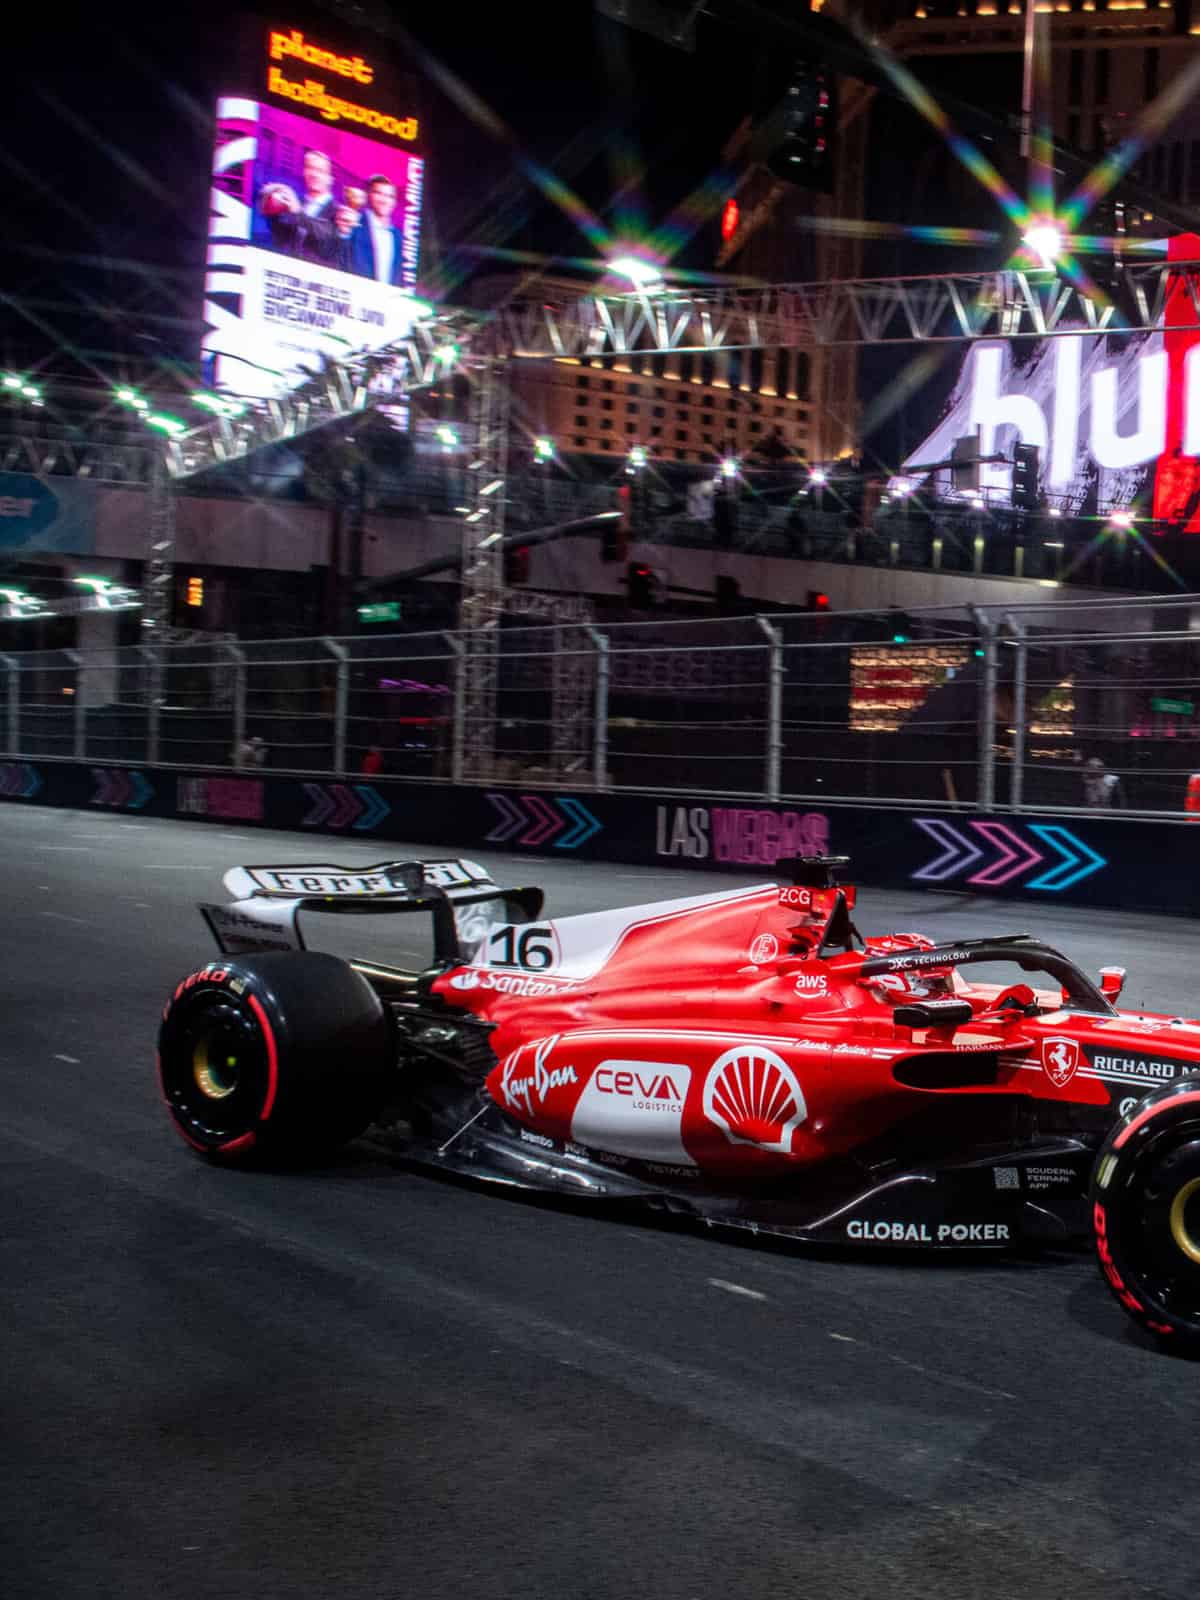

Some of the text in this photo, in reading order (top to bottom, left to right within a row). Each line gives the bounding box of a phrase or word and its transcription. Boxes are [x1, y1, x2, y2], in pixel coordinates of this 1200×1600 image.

[269, 31, 375, 85] planet
[267, 66, 419, 141] hollywood
[656, 806, 710, 858] LAS
[779, 885, 812, 906] ZCG
[488, 925, 554, 973] 16
[914, 951, 971, 966] TECHNOLOGY
[796, 973, 828, 991] aws
[1093, 1055, 1175, 1078] RICHARD
[632, 1101, 683, 1113] LOGISTICS
[1025, 1167, 1075, 1176] SCUDERIA
[1026, 1174, 1069, 1183] FERRARI
[846, 1220, 1010, 1241] GLOBAL POKER
